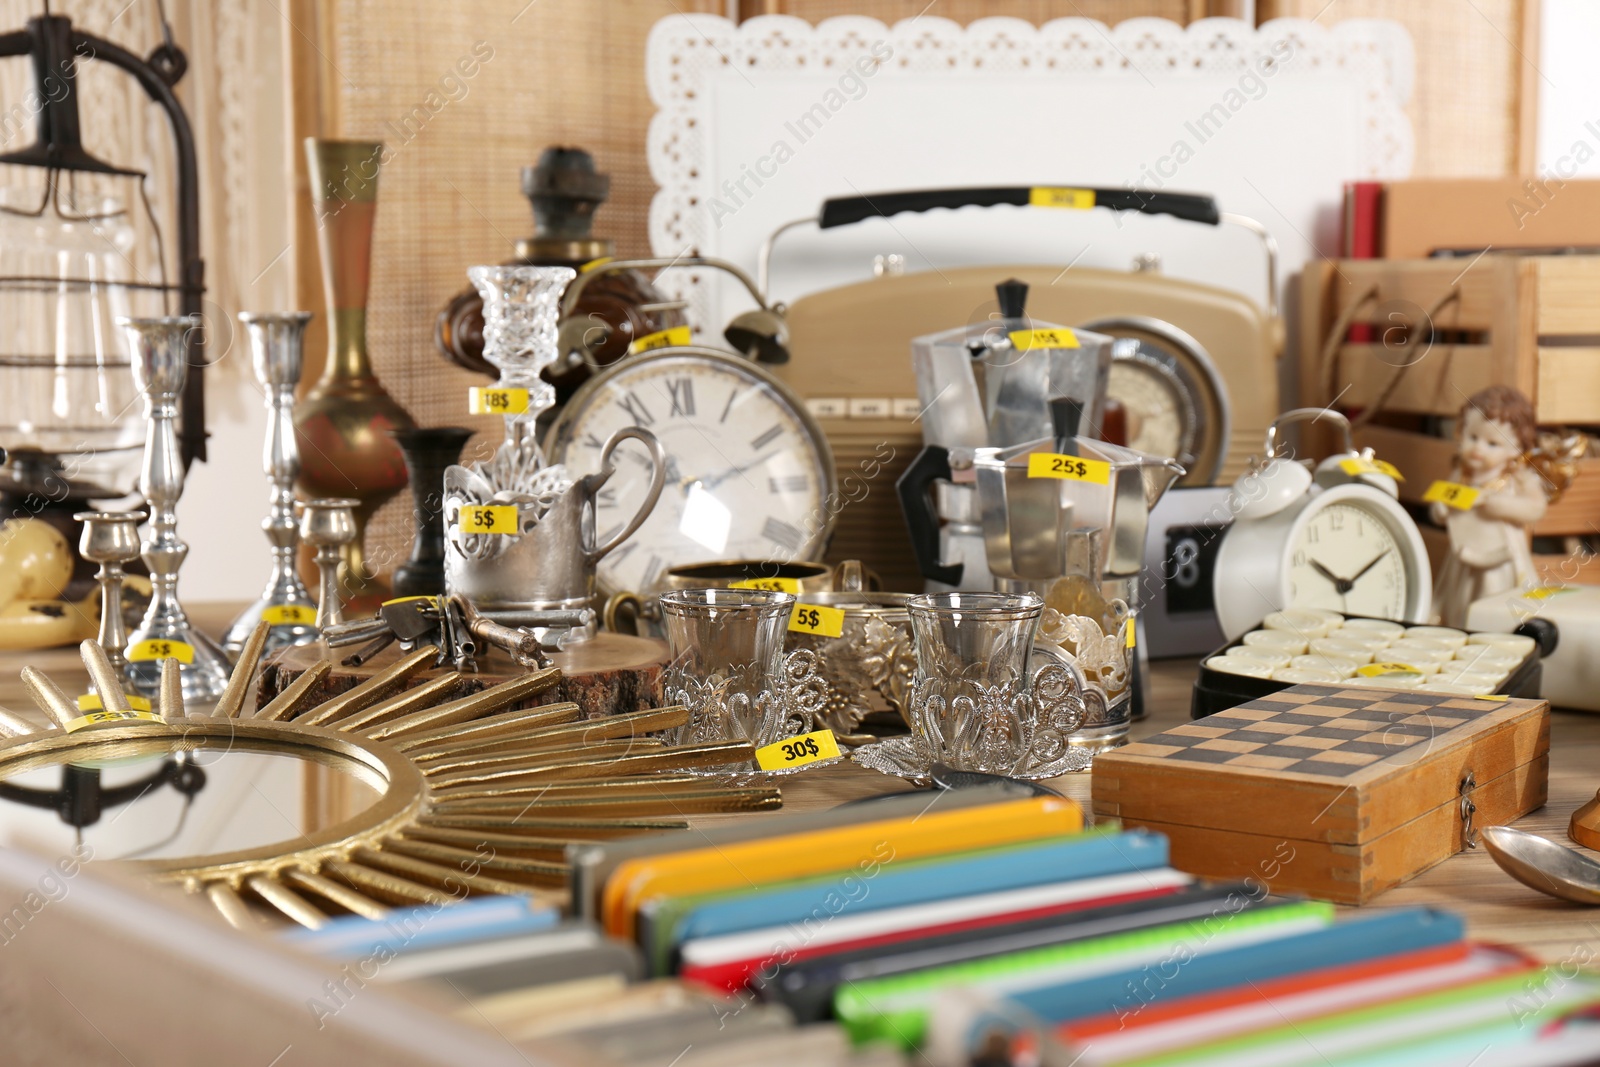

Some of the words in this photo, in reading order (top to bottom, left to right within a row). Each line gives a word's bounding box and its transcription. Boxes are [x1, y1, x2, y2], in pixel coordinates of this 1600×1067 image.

[1034, 332, 1059, 345] 15$
[485, 392, 509, 409] 18$
[665, 377, 696, 418] XII
[1052, 458, 1087, 478] 25$
[474, 510, 495, 530] 5$
[1330, 511, 1344, 531] 12
[1307, 525, 1319, 544] 11
[1174, 537, 1200, 589] 8
[797, 609, 820, 630] 5$
[150, 642, 171, 656] 5$
[781, 737, 820, 761] 30$
